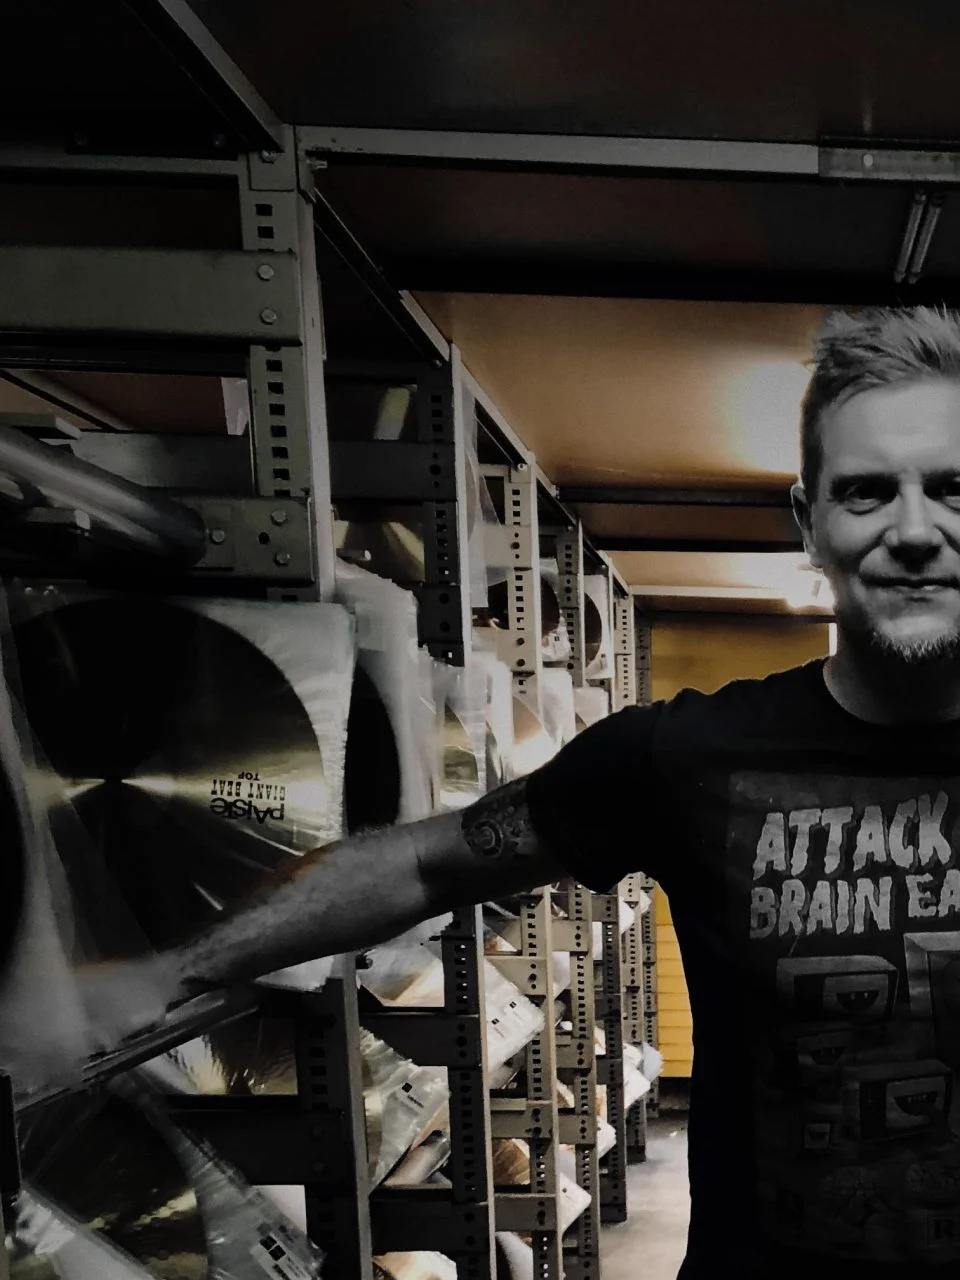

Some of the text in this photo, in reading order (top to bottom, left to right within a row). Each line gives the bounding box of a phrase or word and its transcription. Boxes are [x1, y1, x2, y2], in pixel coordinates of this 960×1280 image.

[211, 779, 285, 801] GIANT BEAT
[238, 772, 260, 781] TOP
[753, 790, 951, 880] ATTACK
[750, 875, 893, 939] BRAIN
